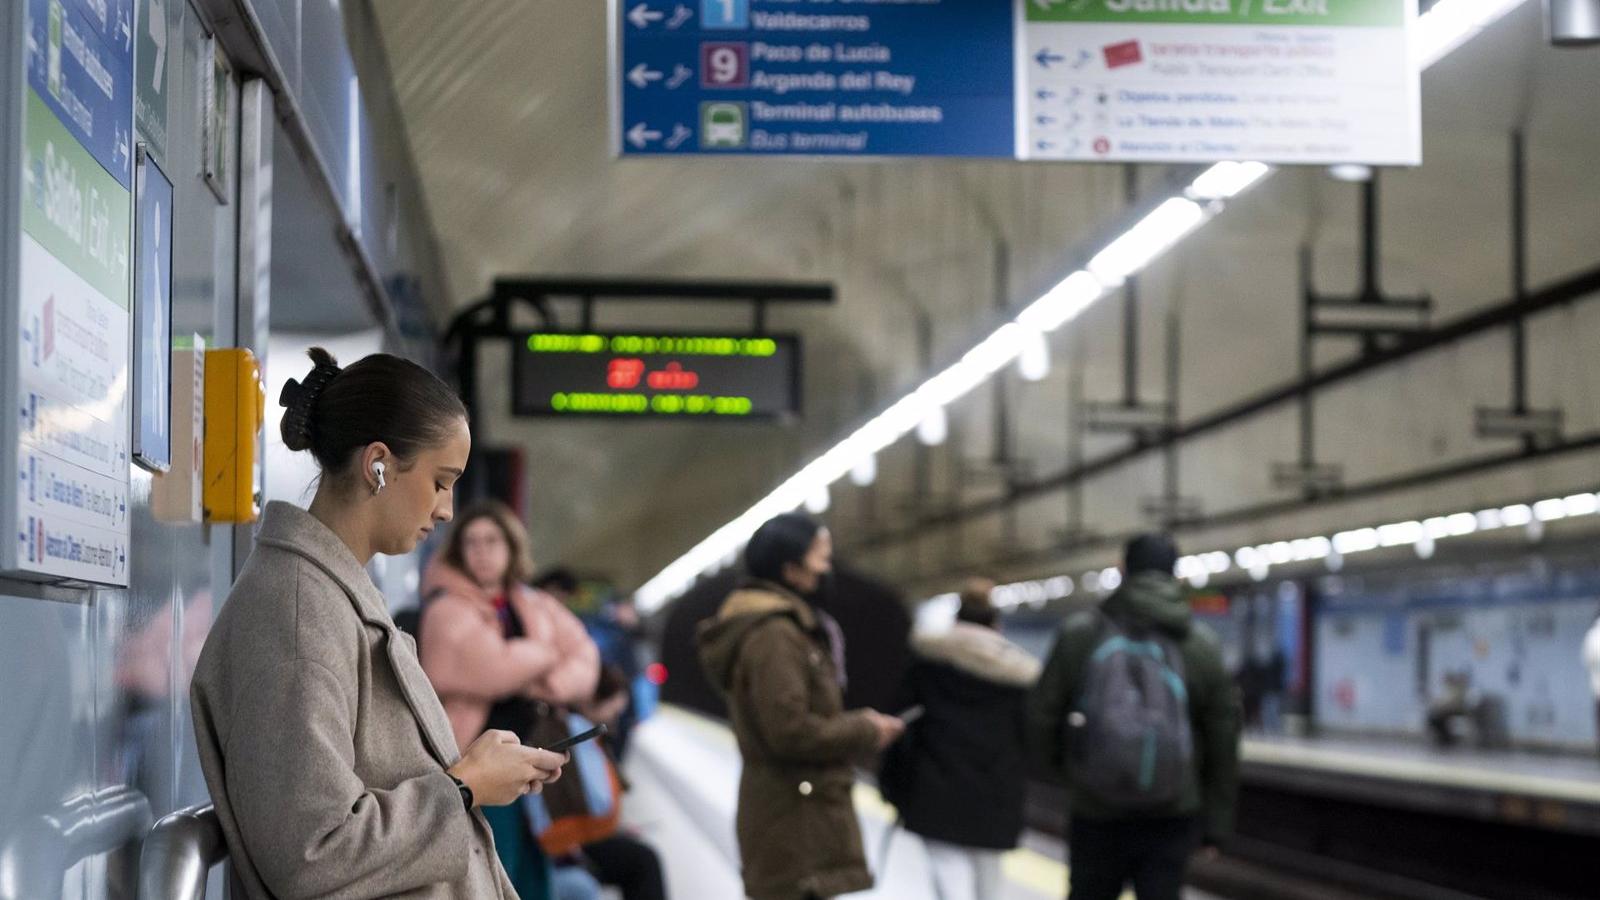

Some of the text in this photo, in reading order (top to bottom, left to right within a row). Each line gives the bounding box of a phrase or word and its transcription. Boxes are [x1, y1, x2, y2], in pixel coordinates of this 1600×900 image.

[752, 11, 870, 31] Valdecarros
[752, 42, 802, 62] Paco
[804, 42, 833, 62] de
[711, 48, 738, 83] 9
[752, 70, 916, 95] Arganda del Rey
[752, 101, 943, 123] Terminal autobuses
[751, 129, 868, 149] Bus terminal
